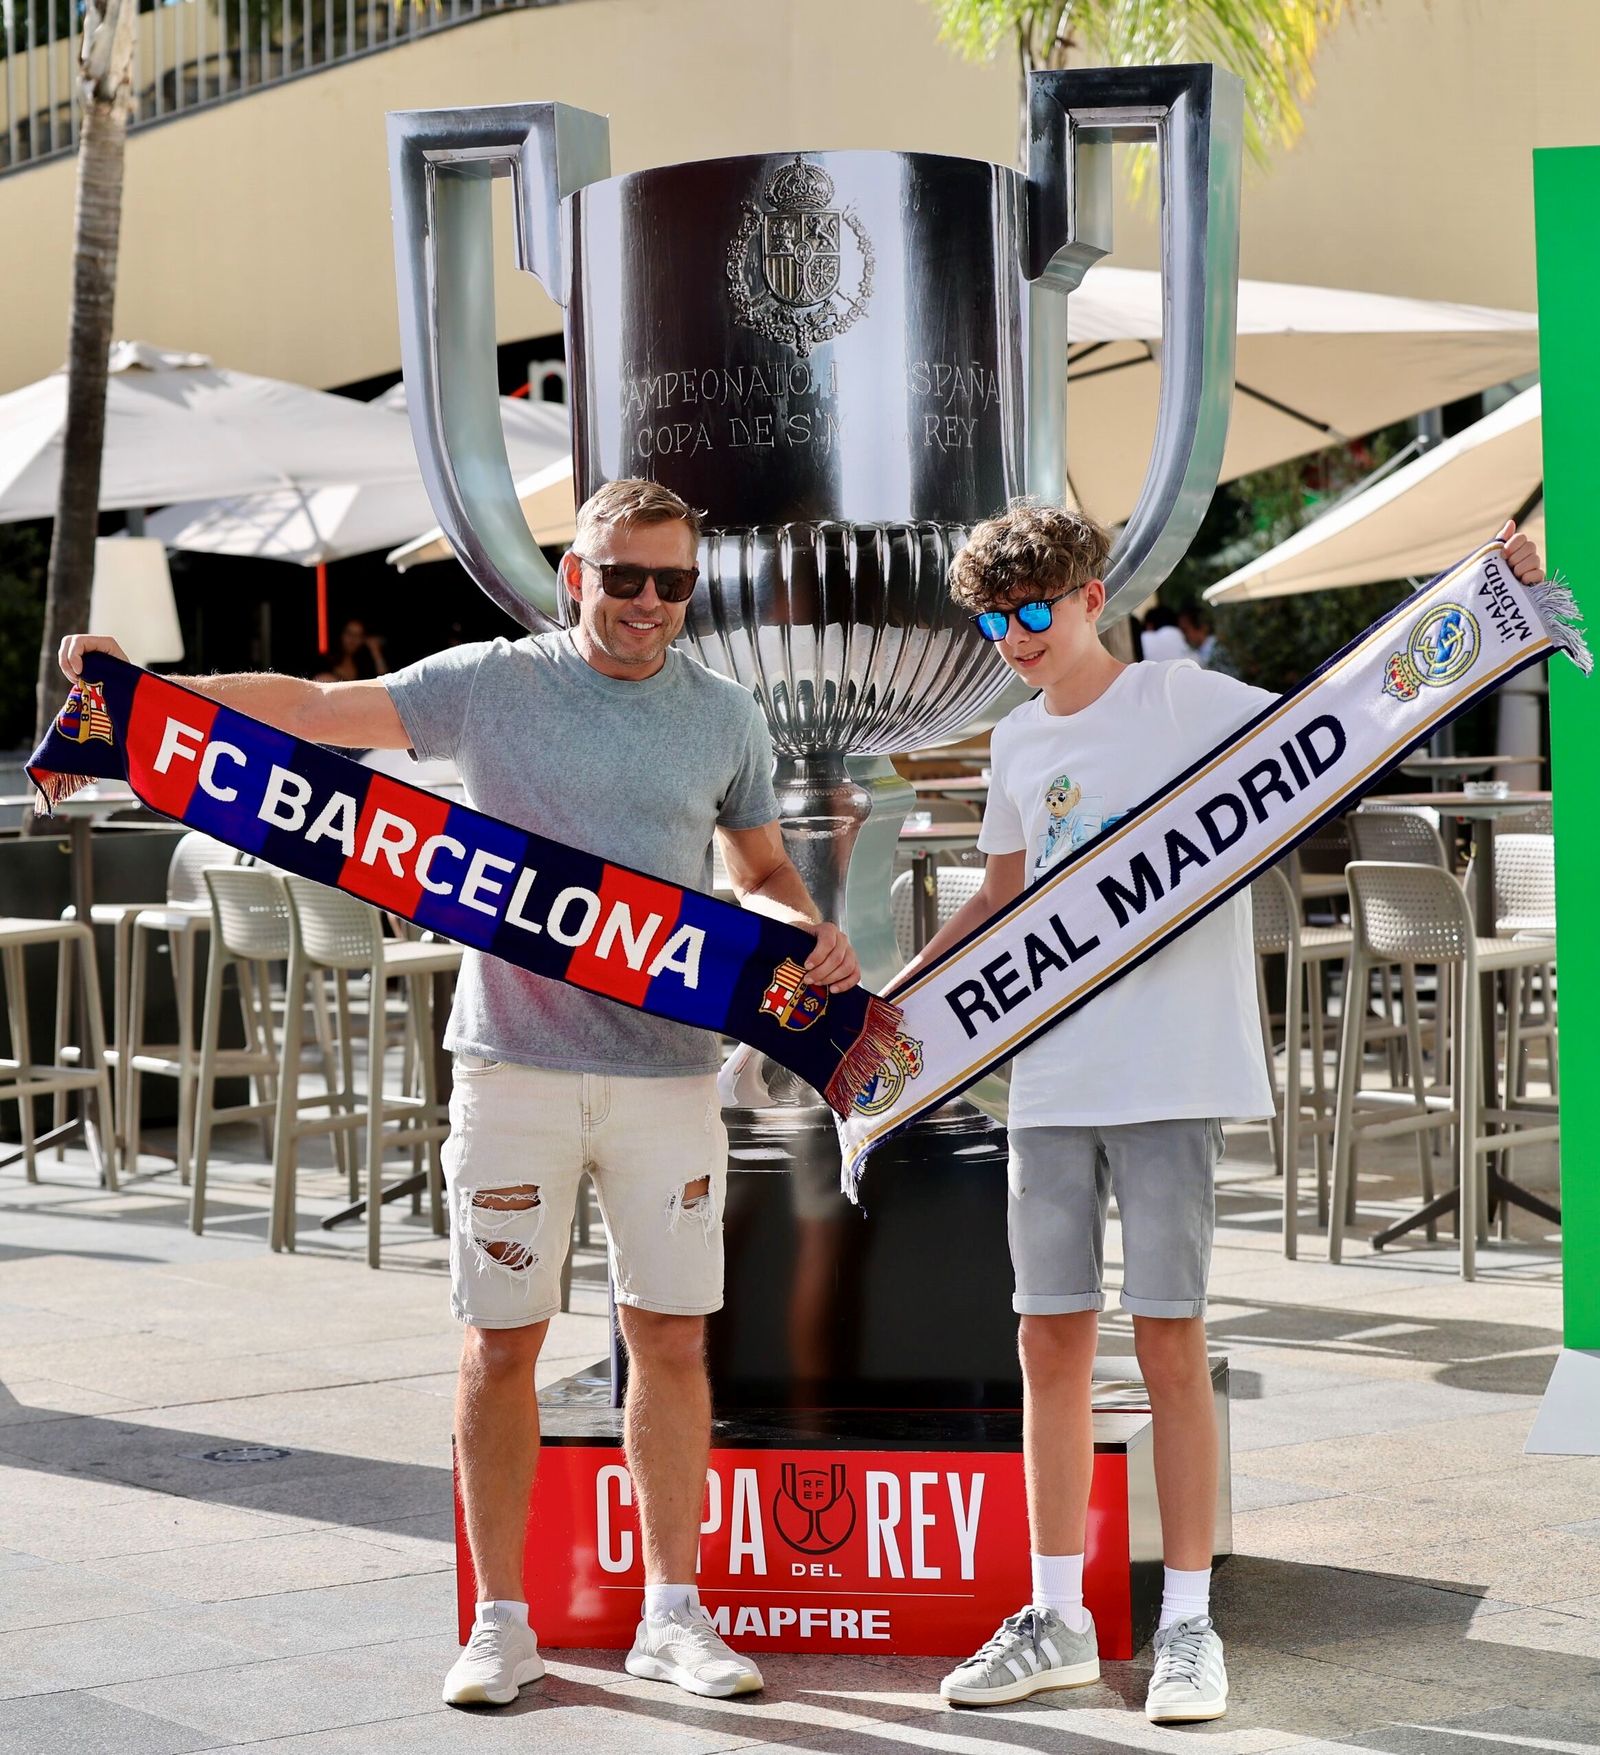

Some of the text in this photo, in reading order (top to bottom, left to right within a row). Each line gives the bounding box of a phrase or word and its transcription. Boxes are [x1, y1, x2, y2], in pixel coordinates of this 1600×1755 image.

[905, 359, 1000, 412] SPAÑA
[637, 421, 713, 458] COPA
[728, 413, 775, 448] DE
[924, 412, 979, 454] REY
[1482, 556, 1533, 641] MADRID!
[153, 716, 706, 990] FC BARCELONA
[944, 714, 1347, 1040] REAL MADRID
[596, 1464, 986, 1580] CPA DEL REY
[700, 1606, 891, 1640] MAPFRE
